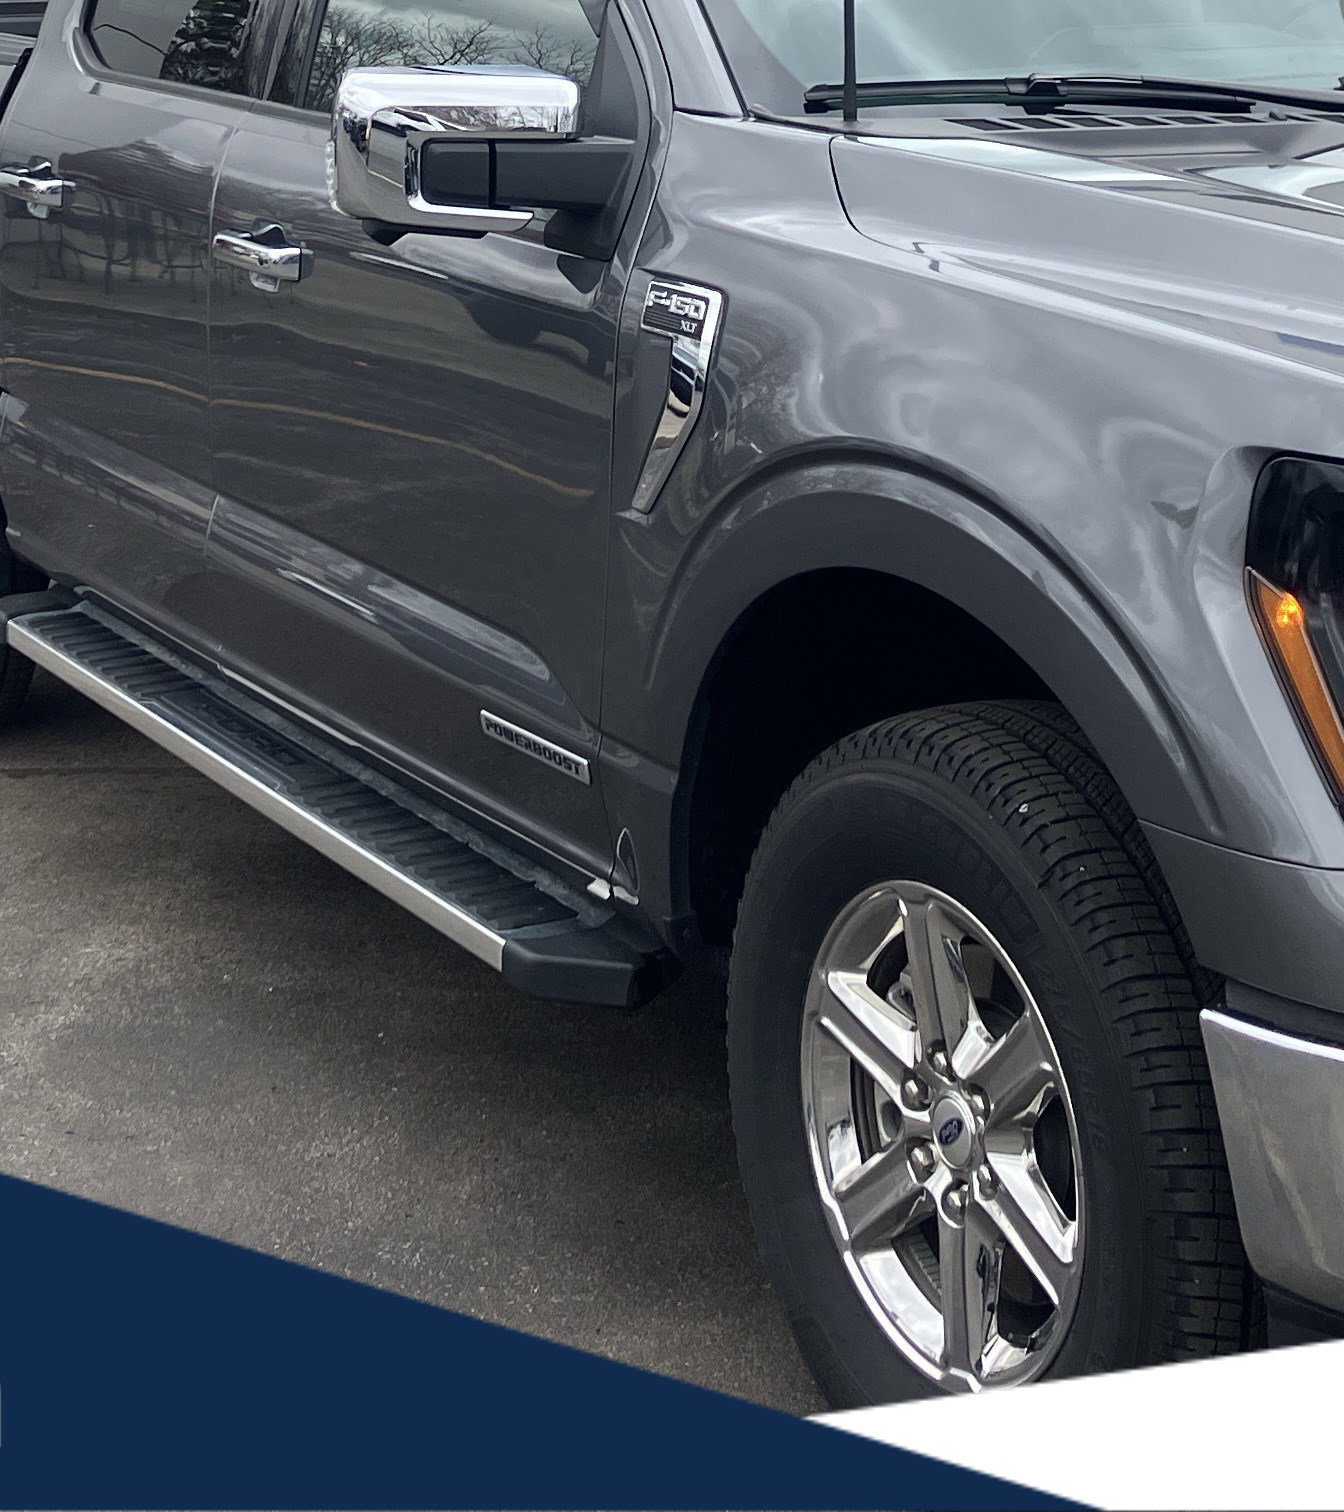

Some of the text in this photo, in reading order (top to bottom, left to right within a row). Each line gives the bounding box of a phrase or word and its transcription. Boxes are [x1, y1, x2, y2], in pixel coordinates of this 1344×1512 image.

[647, 290, 707, 321] F-150
[680, 319, 698, 334] XLT
[483, 715, 582, 778] POWERBOOST
